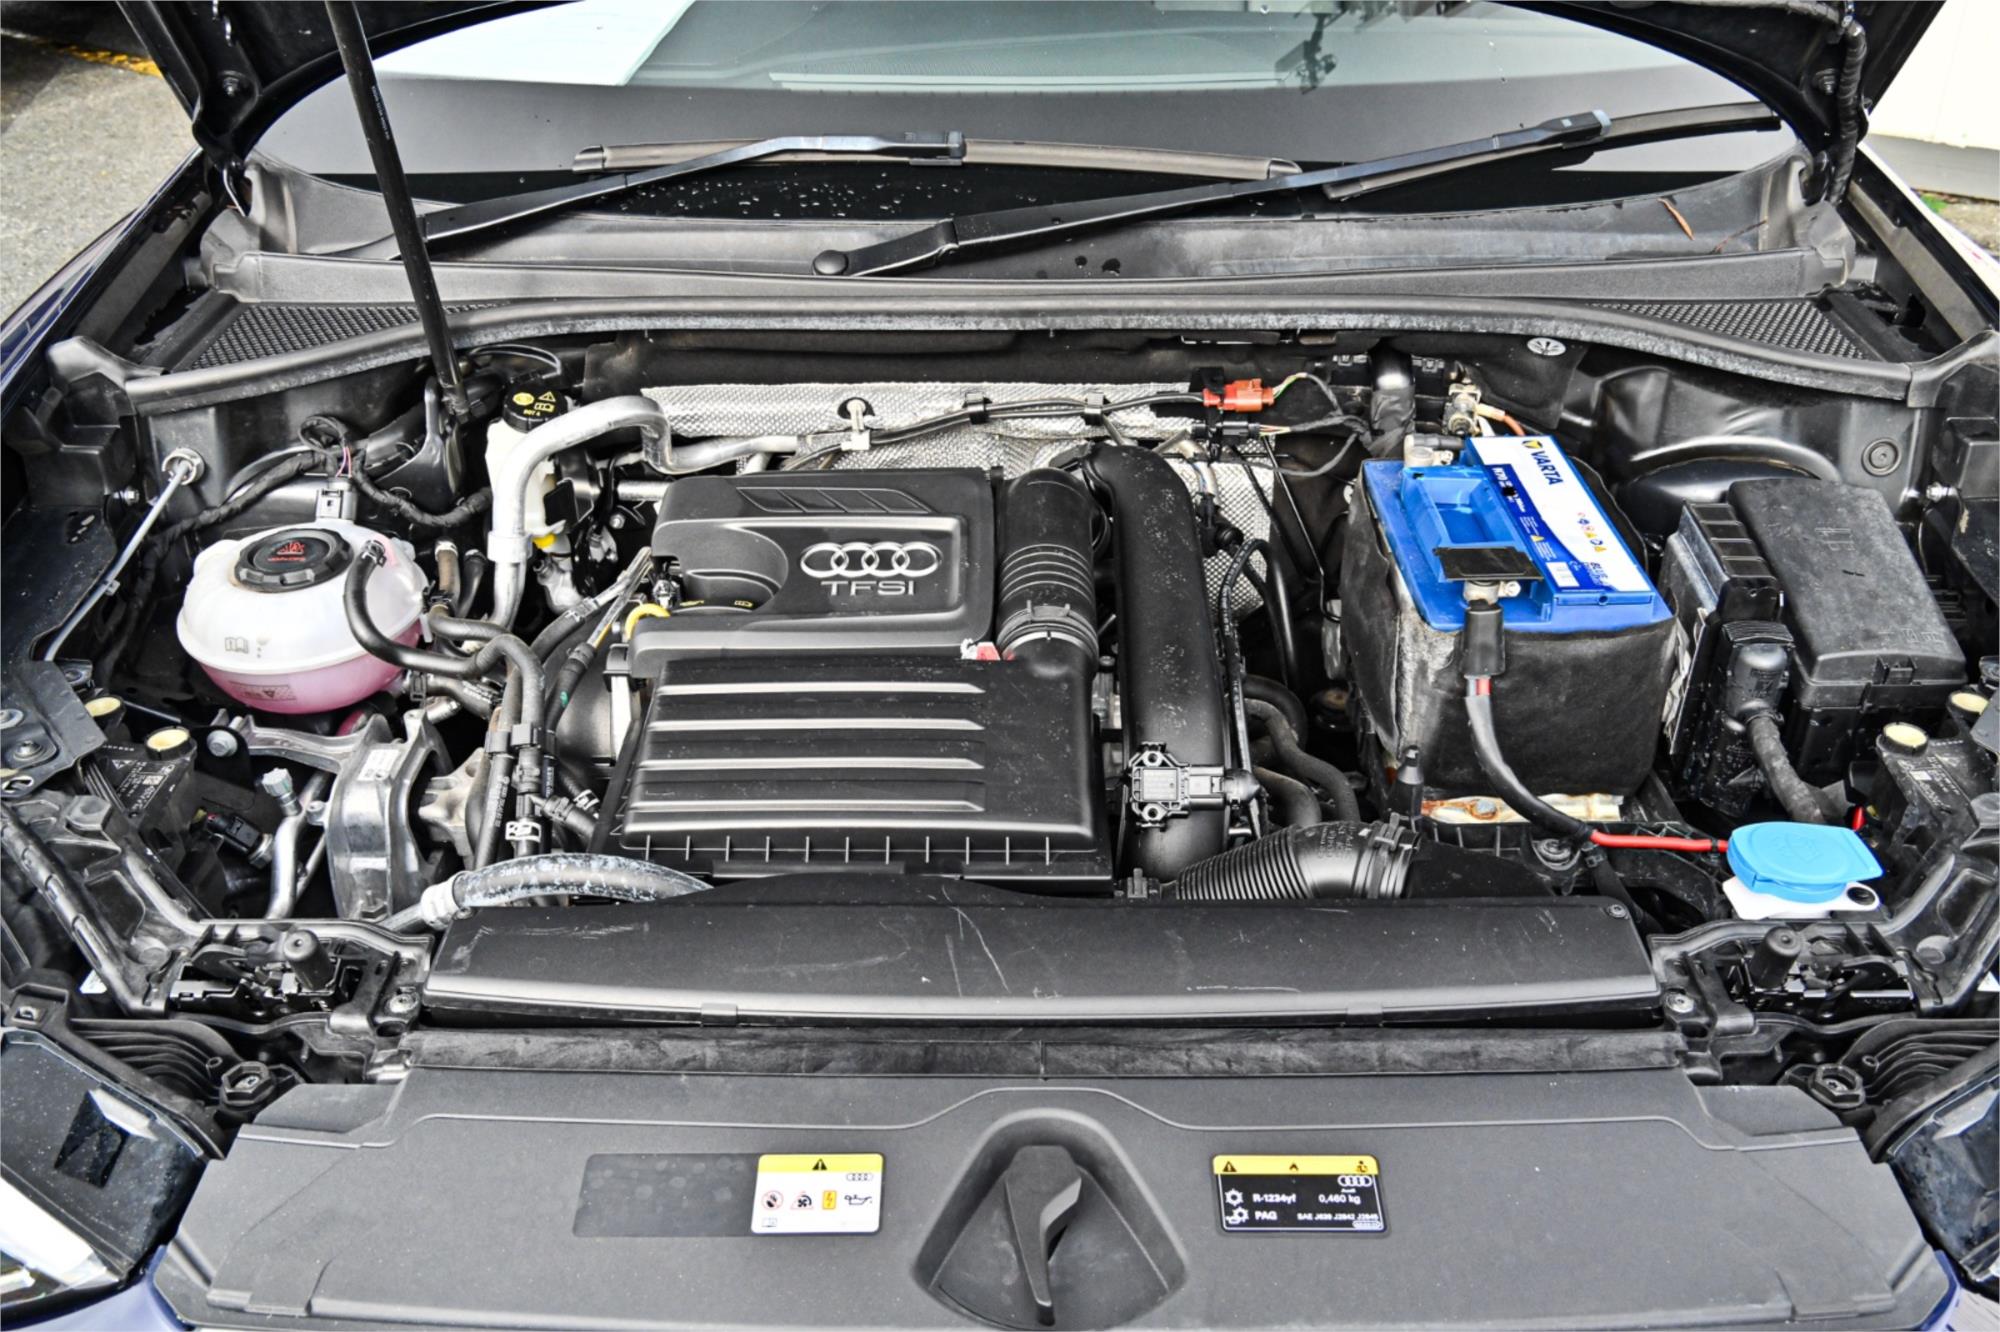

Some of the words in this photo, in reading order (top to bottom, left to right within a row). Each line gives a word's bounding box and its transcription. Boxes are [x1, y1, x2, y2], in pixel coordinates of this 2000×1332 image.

[1530, 450, 1564, 486] VARTA
[820, 580, 915, 596] TFSI
[1252, 1193, 1297, 1204] R-1234yf
[1348, 1195, 1361, 1205] kg
[1254, 1210, 1278, 1220] PAG
